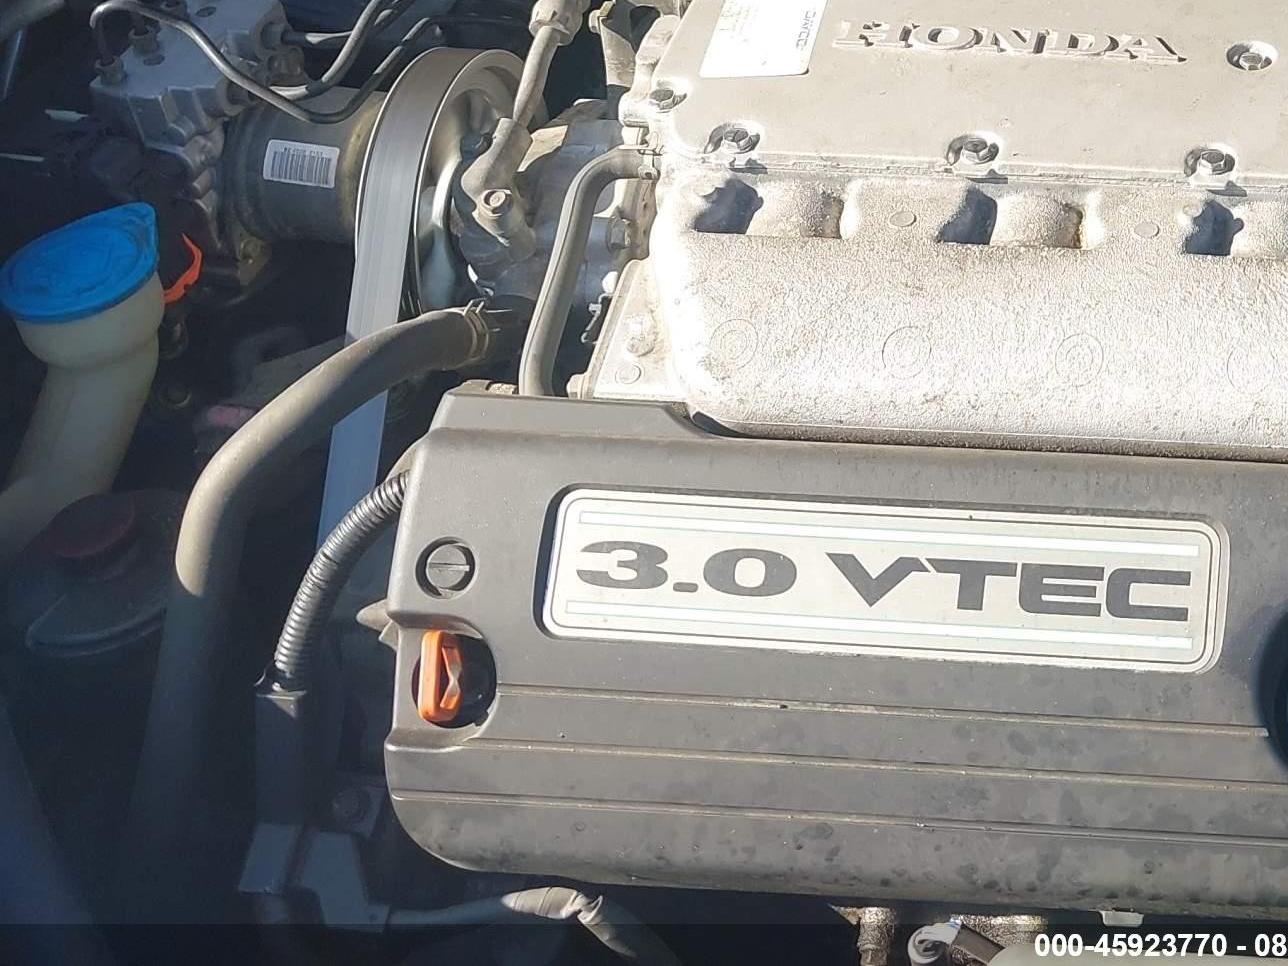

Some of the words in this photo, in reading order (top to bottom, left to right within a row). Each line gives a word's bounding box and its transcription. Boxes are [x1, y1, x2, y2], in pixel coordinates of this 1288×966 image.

[832, 19, 1188, 62] HONDA
[576, 540, 797, 597] 3.0
[824, 551, 1192, 622] VTEC
